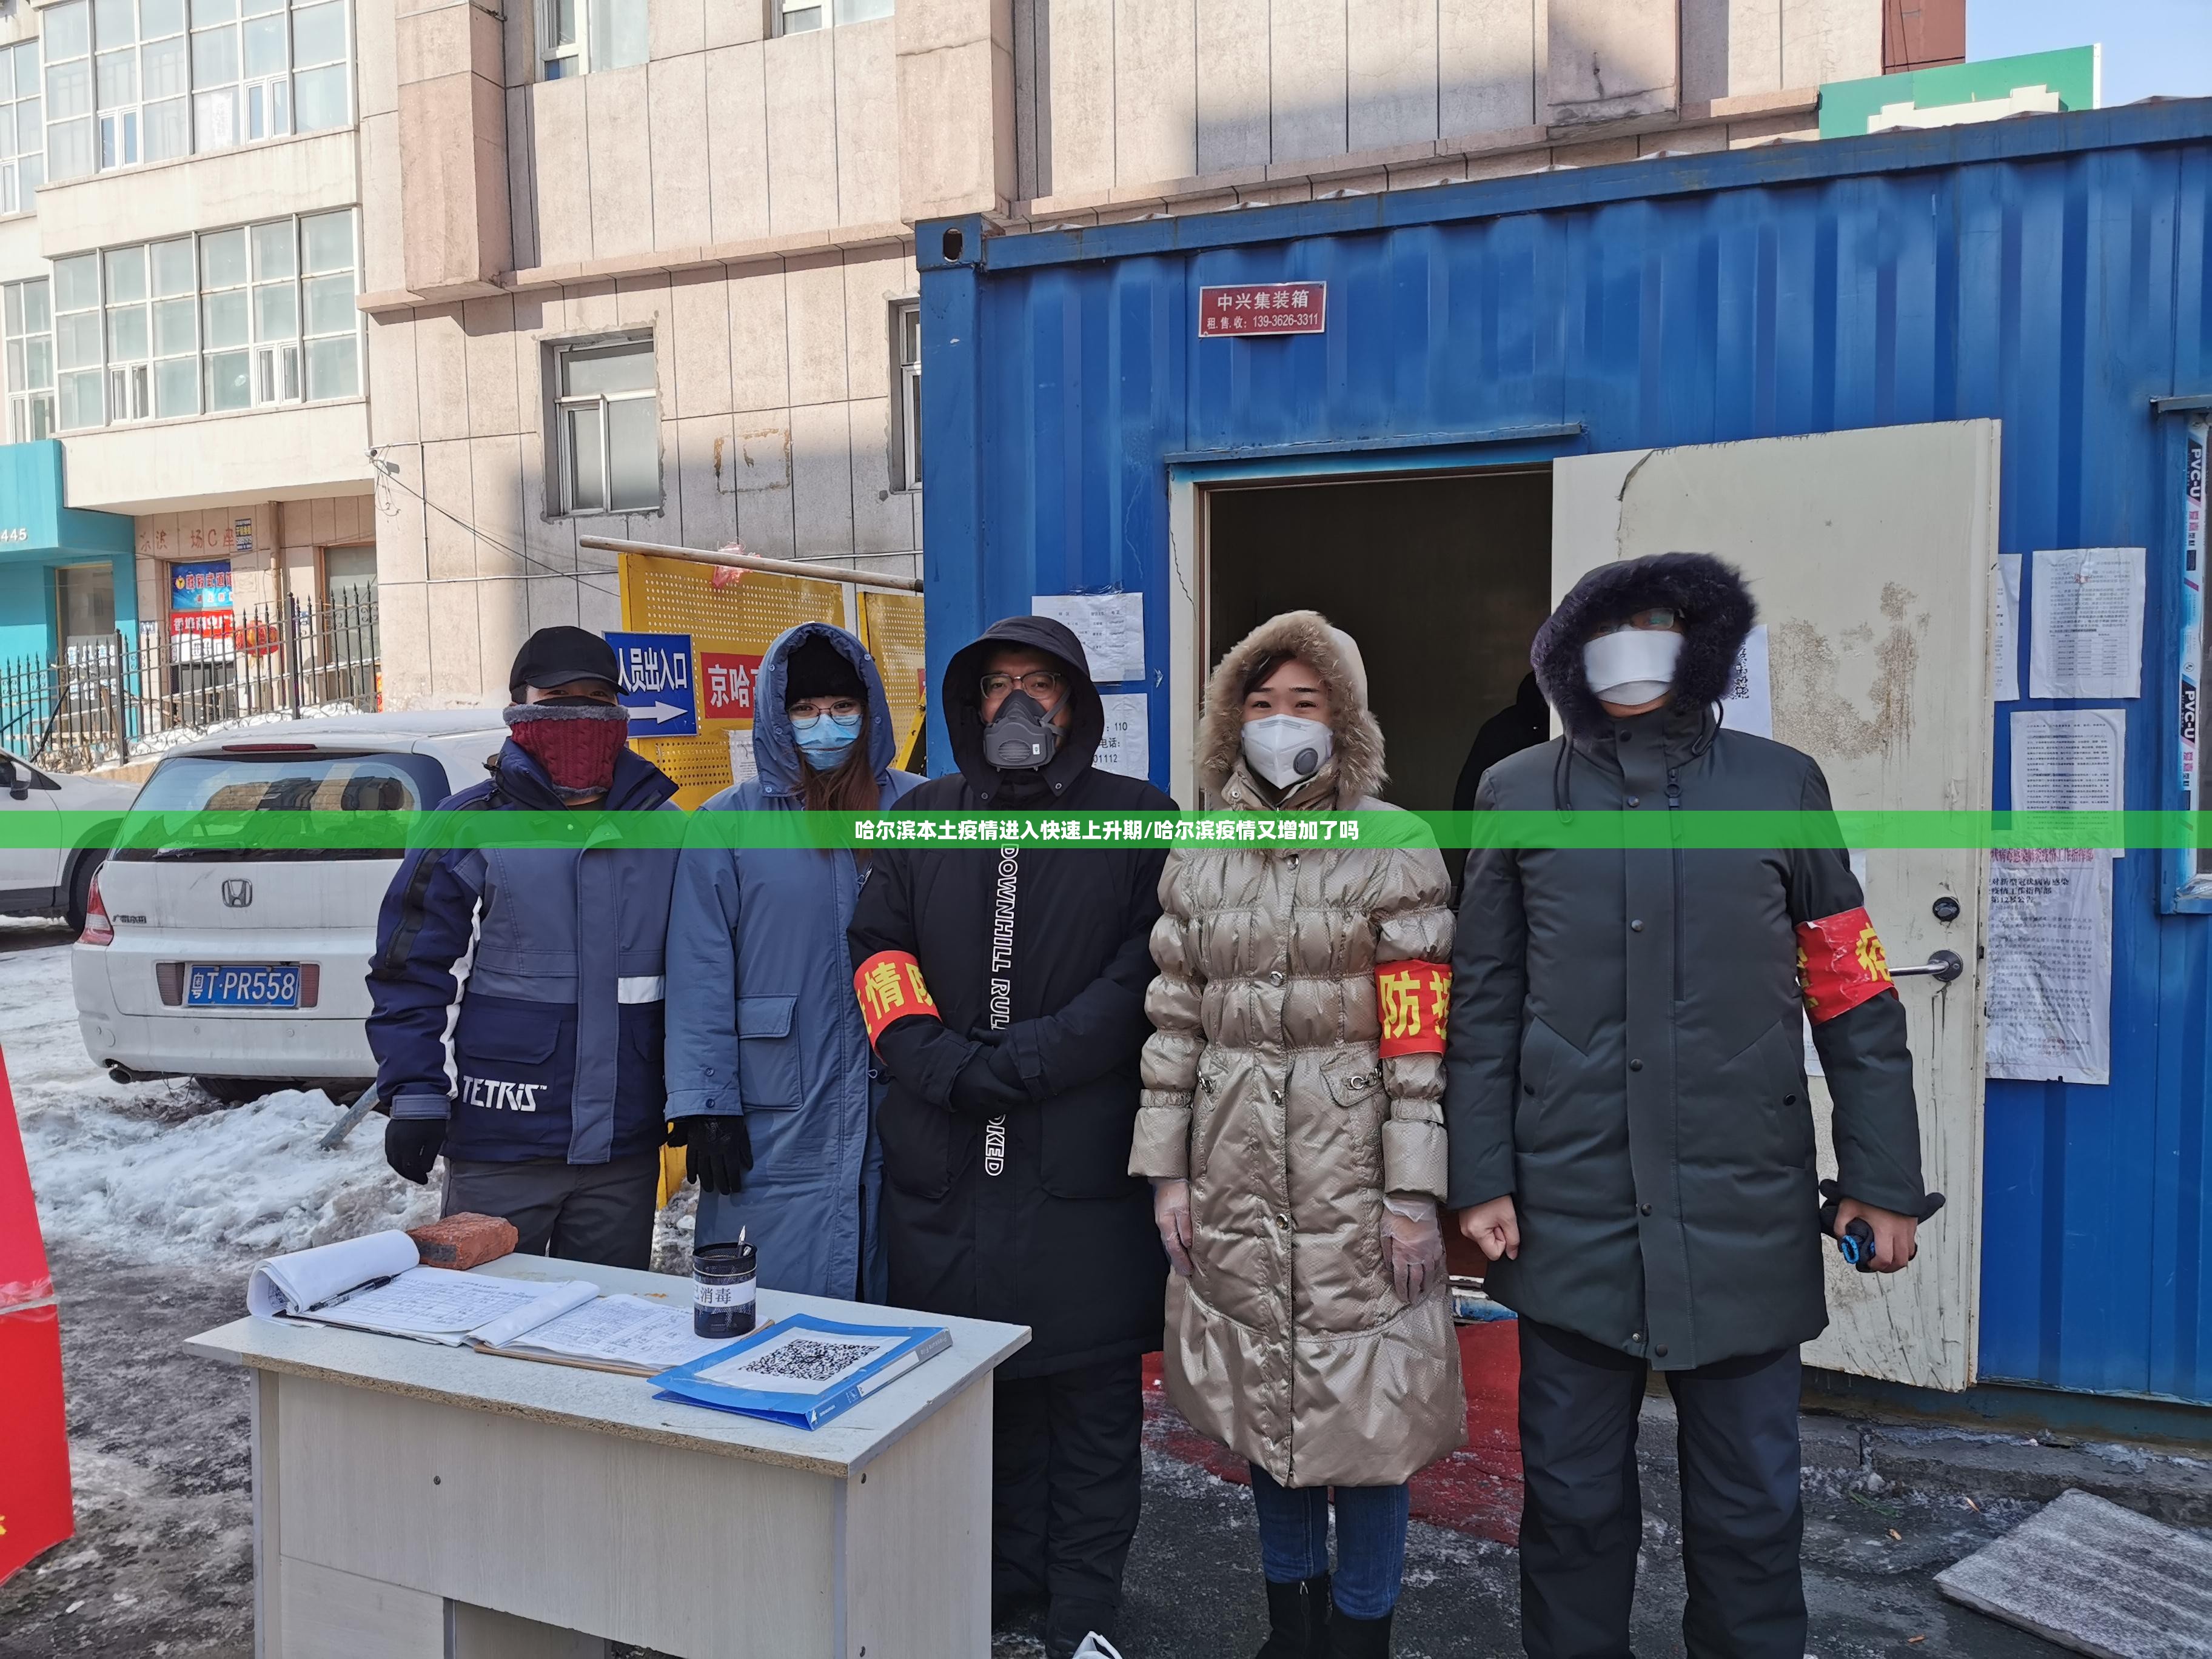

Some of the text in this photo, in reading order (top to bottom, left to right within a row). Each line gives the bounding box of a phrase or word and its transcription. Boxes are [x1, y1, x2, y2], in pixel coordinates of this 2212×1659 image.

[1217, 290, 1309, 312] 中兴集装箱
[1253, 313, 1318, 327] 139-3626-3311
[2190, 448, 2202, 498] PVC-U
[1, 528, 27, 541] 445
[617, 647, 688, 693] 人员出入口
[2184, 690, 2195, 739] PVC-U
[1099, 737, 1120, 748] 电话:
[1989, 877, 2070, 886] 对新型冠状病毒感染
[992, 843, 1019, 973] DOWNHILL
[990, 978, 1010, 1030] RUL
